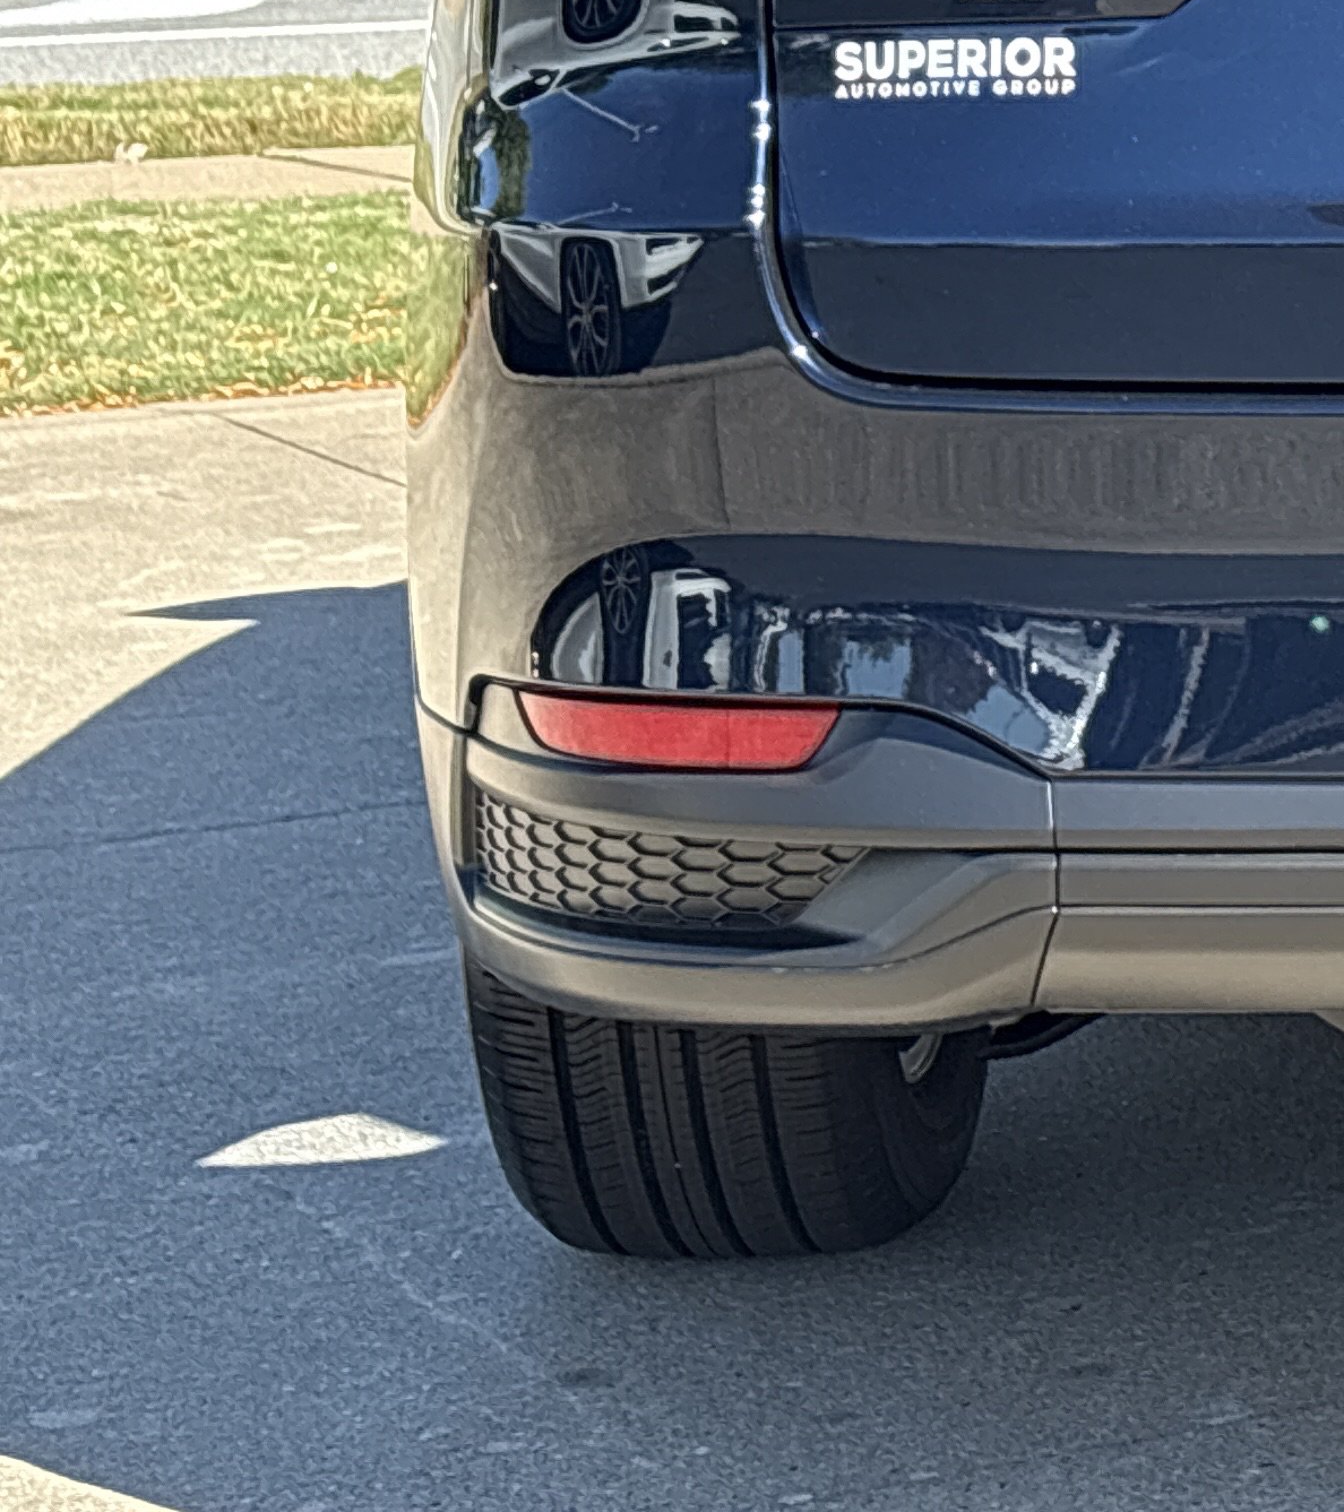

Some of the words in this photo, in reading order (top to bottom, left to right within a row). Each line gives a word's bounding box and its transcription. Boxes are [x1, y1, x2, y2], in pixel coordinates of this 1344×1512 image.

[834, 36, 1077, 82] SUPERIOR
[834, 80, 981, 100] AUTOMOTIVE
[992, 78, 1077, 97] GROUP
